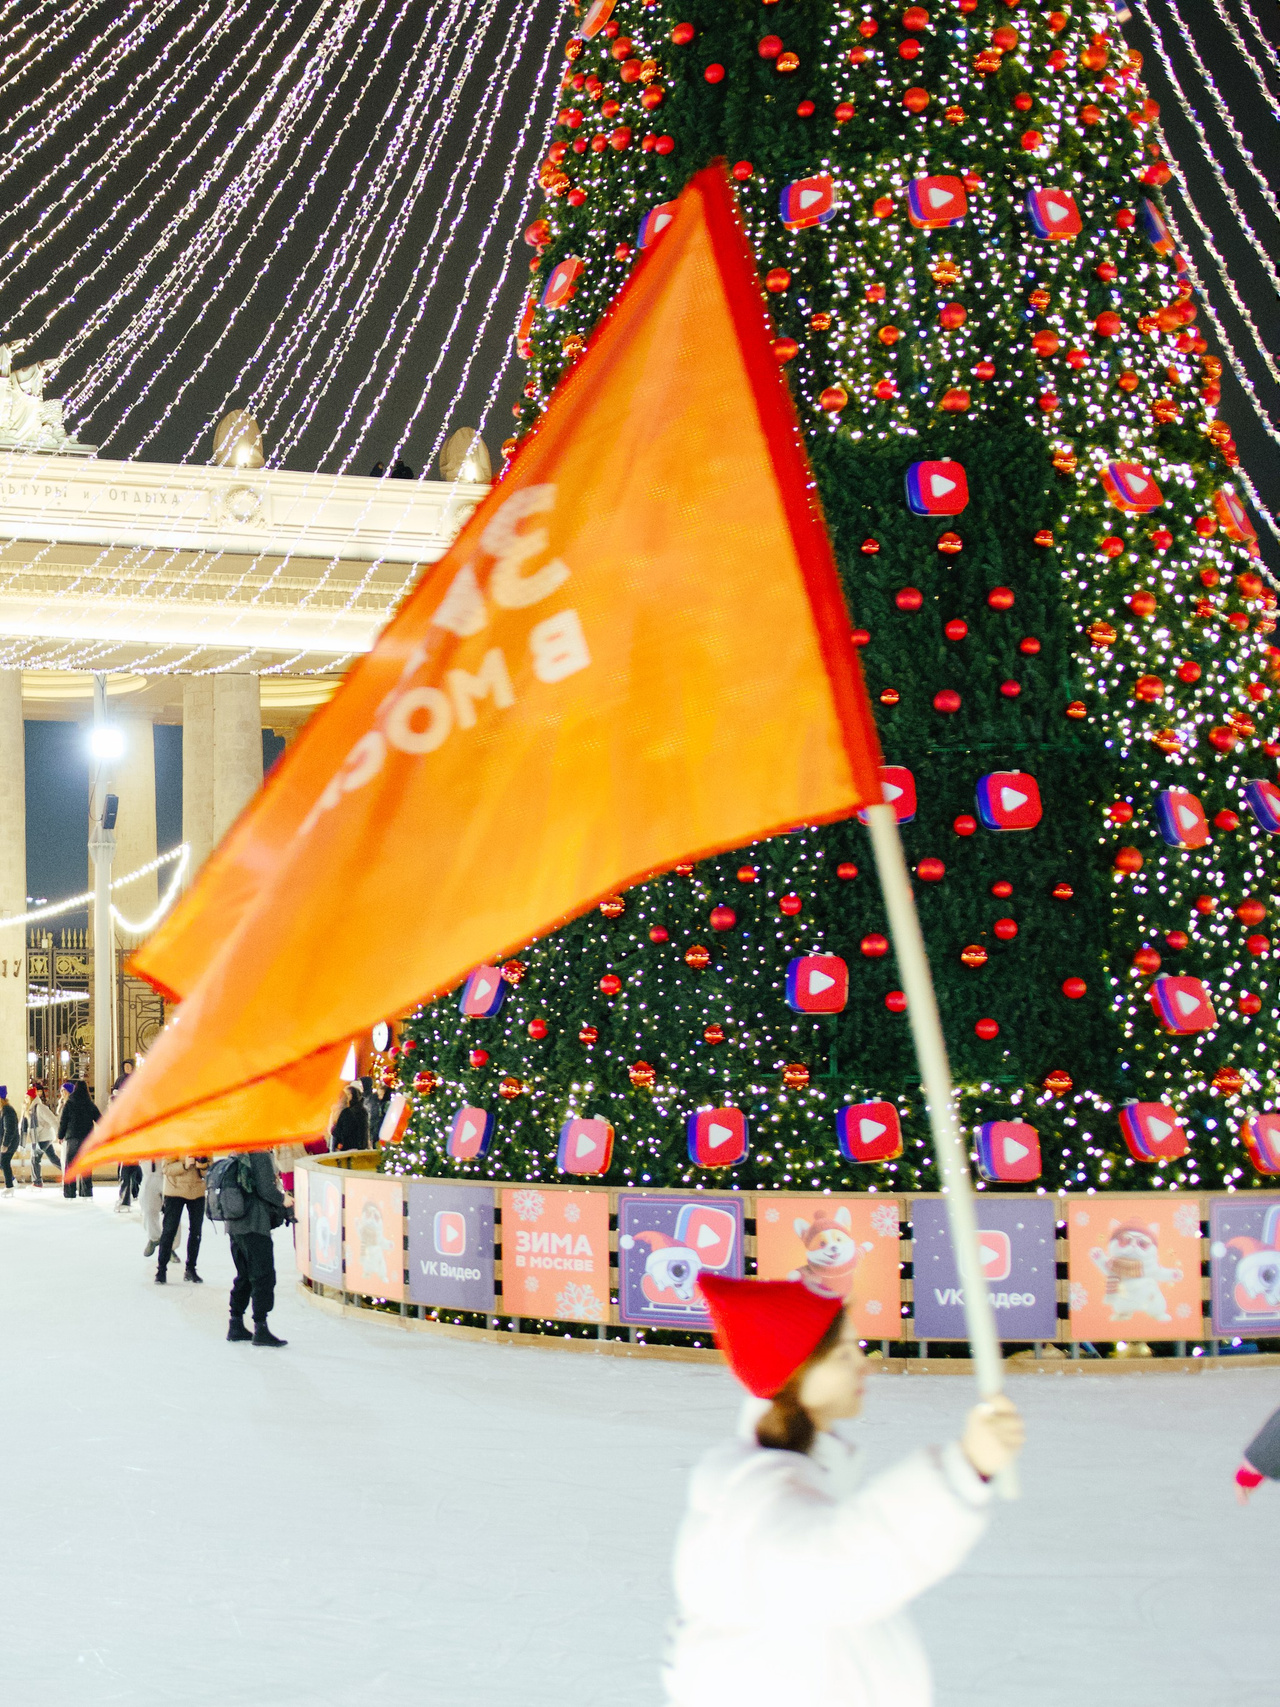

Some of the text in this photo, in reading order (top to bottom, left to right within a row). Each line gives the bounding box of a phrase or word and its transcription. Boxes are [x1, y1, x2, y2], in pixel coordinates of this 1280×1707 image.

[109, 488, 180, 505] ОТДЫХА
[516, 1231, 594, 1256] ЗИМА
[420, 1260, 482, 1281] VK Видео
[516, 1255, 594, 1272] В МОСКВЕ
[934, 1288, 1036, 1309] VK идео
